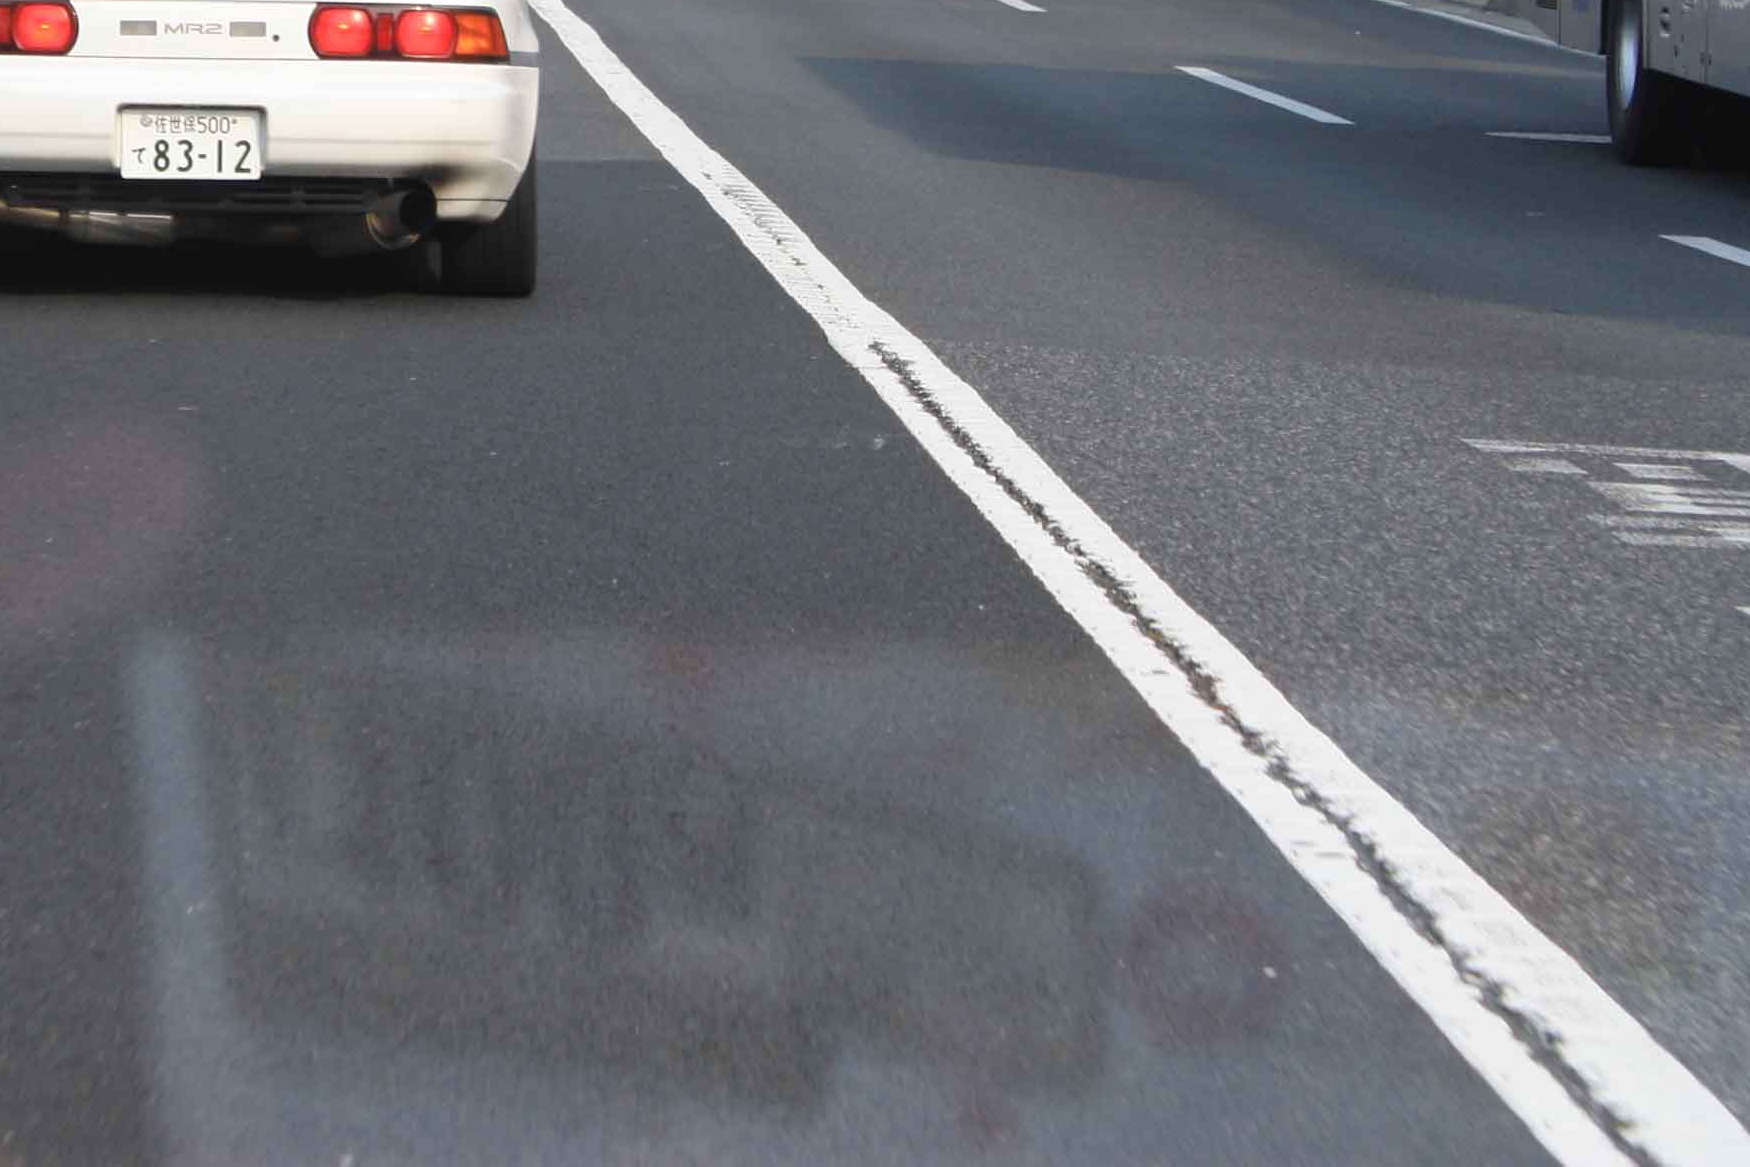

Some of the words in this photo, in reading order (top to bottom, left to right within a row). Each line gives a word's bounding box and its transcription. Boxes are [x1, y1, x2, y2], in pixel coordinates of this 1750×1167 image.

[163, 21, 223, 36] MR2
[131, 148, 146, 165] て
[153, 139, 252, 174] 83-12
